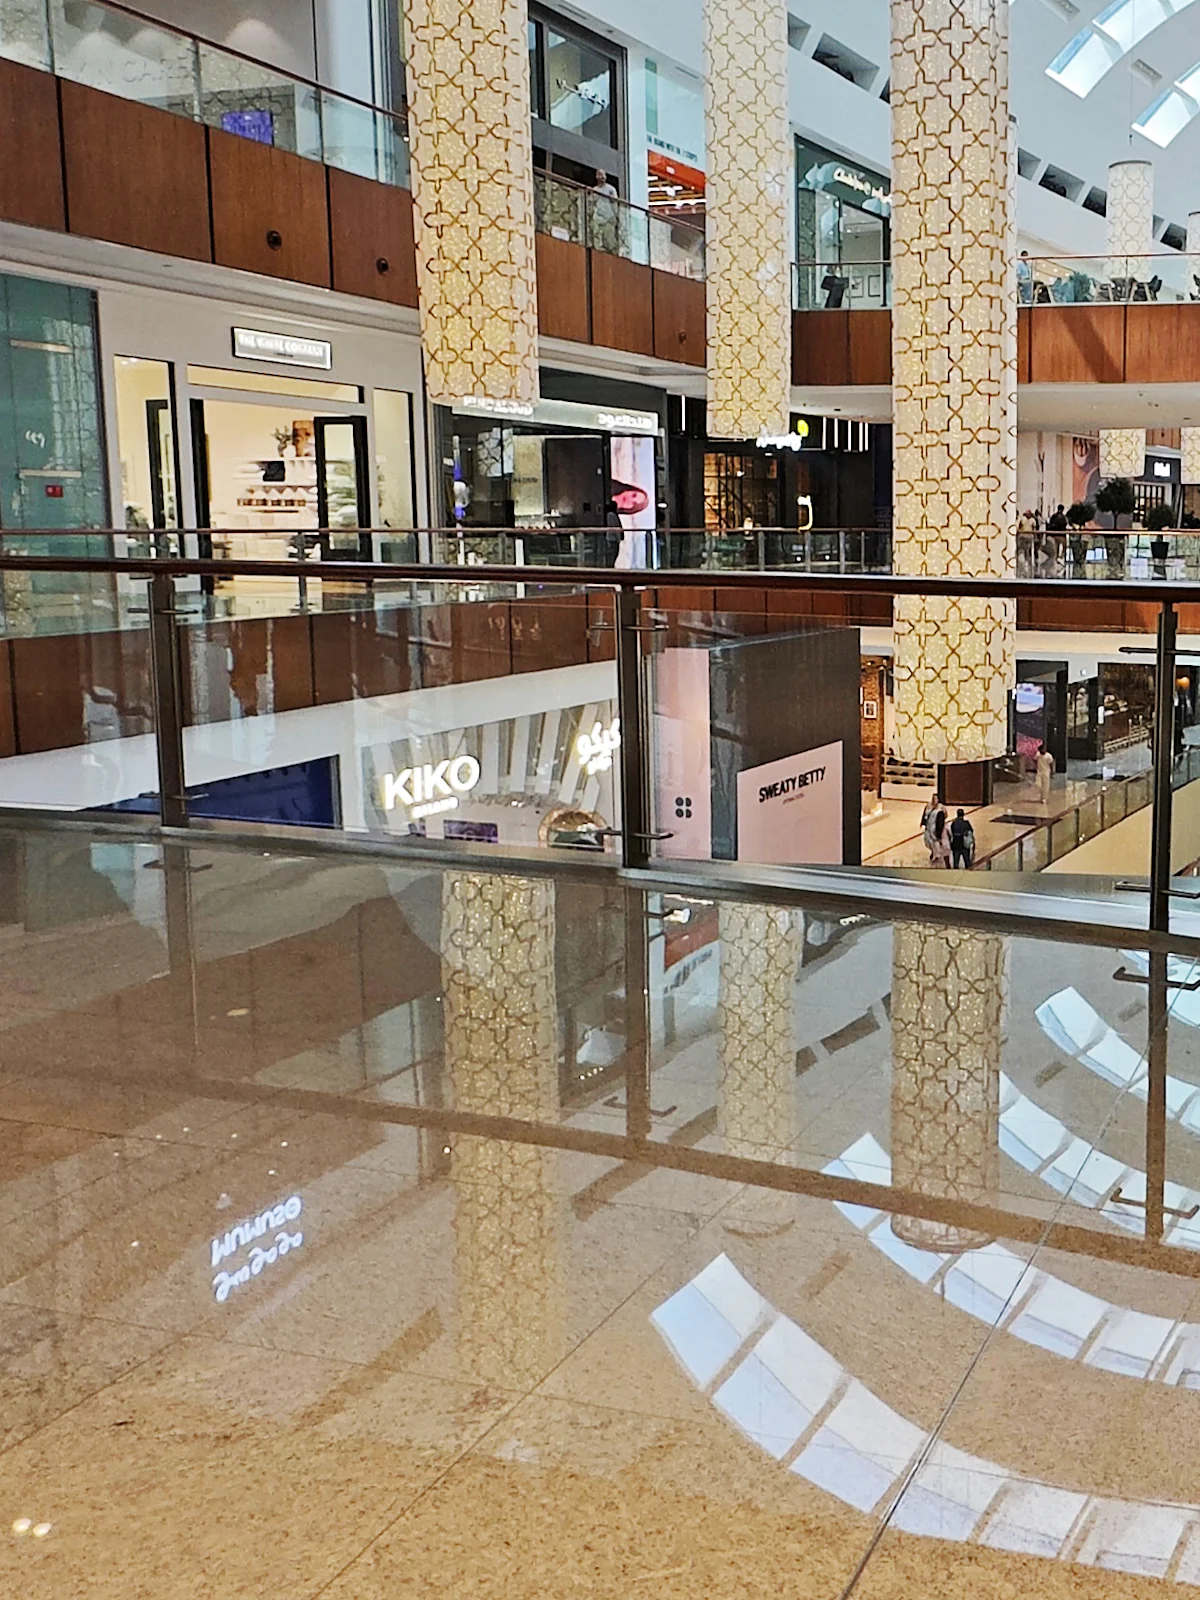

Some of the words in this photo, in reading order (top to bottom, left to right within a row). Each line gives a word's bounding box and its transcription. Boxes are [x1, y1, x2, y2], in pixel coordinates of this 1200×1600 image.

[384, 754, 481, 811] KIKO
[759, 776, 797, 803] SWEATY
[798, 766, 826, 788] BETTY
